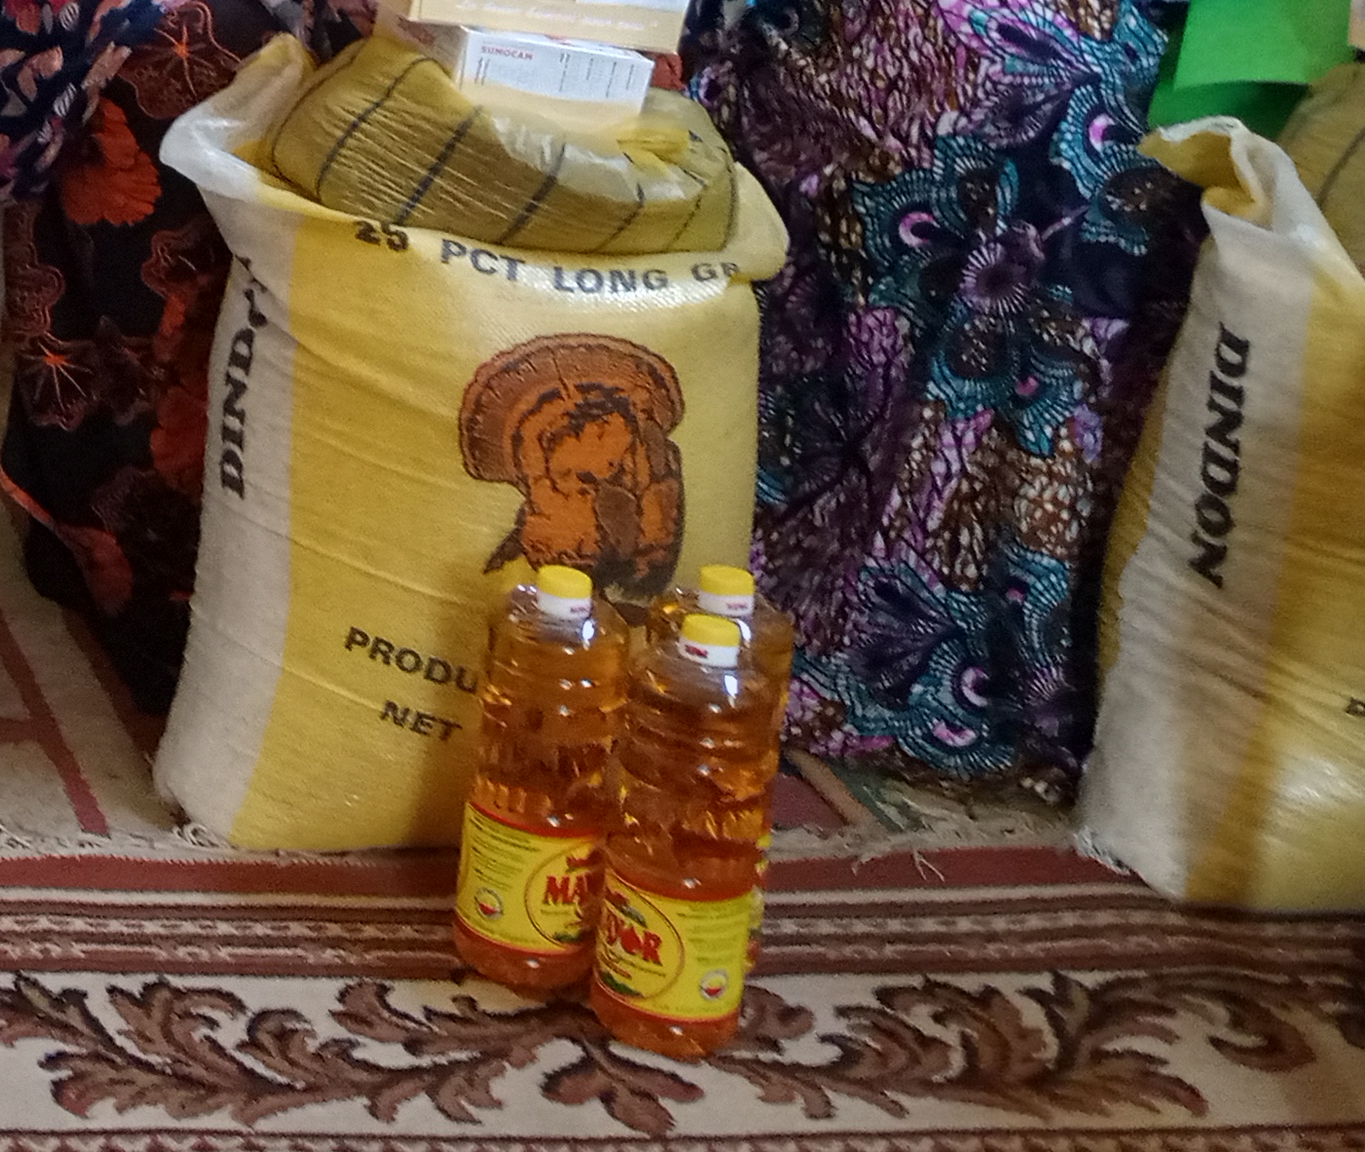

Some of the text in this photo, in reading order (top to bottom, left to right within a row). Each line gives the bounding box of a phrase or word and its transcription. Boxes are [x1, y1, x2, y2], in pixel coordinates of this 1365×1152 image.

[354, 220, 410, 252] 25
[440, 238, 526, 282] PCT
[553, 265, 668, 294] LONG
[1188, 321, 1251, 590] DINDON
[344, 626, 478, 695] PRODU
[380, 700, 463, 742] NET
